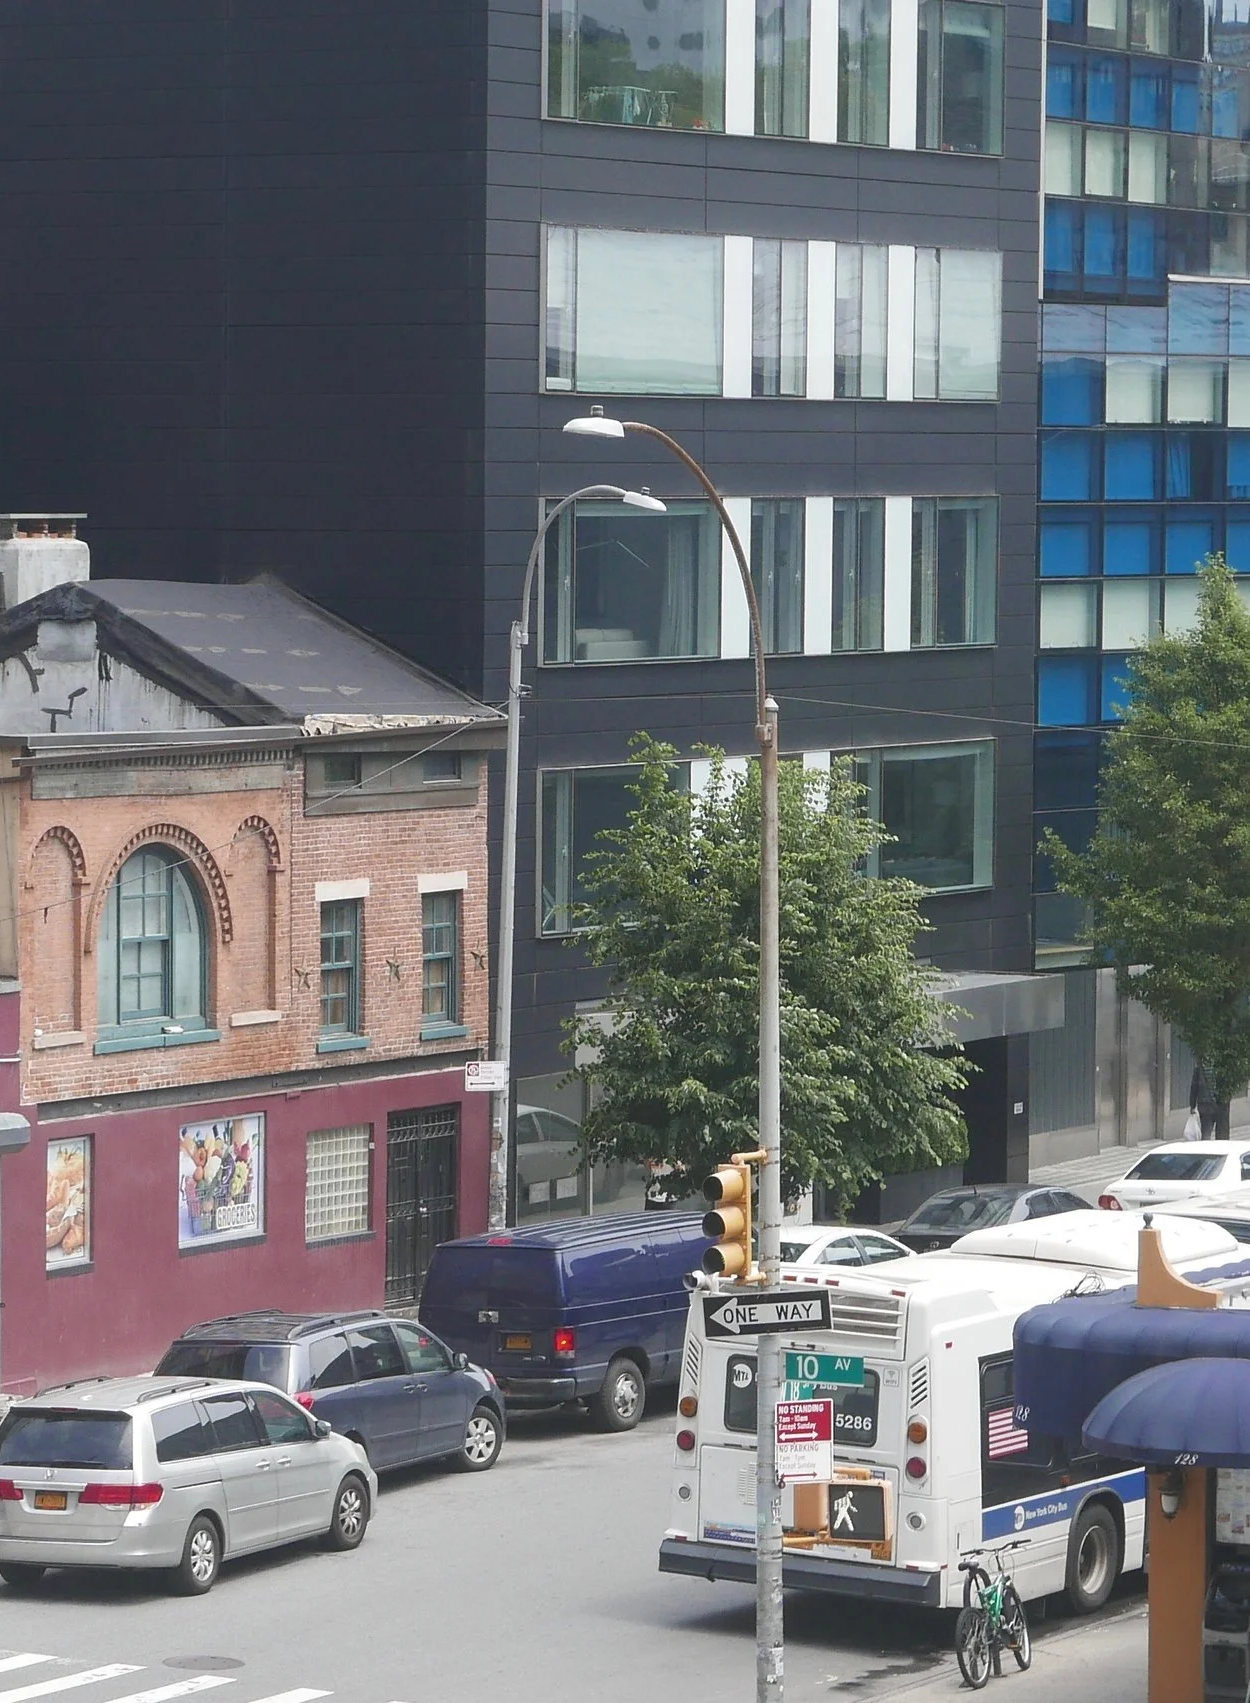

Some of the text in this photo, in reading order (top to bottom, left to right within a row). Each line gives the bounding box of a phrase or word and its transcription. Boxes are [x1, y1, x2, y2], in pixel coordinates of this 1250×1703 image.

[217, 1203, 256, 1228] GROCERIES
[723, 1303, 813, 1324] ONE WAY
[796, 1355, 852, 1380] 10 AV
[778, 1403, 824, 1415] NO STANDING
[779, 1422, 817, 1431] Except Sunday
[835, 1413, 873, 1431] 5286
[779, 1443, 819, 1453] NO PARKING
[1174, 1453, 1199, 1465] 128
[1025, 1502, 1068, 1520] New York City Bus
